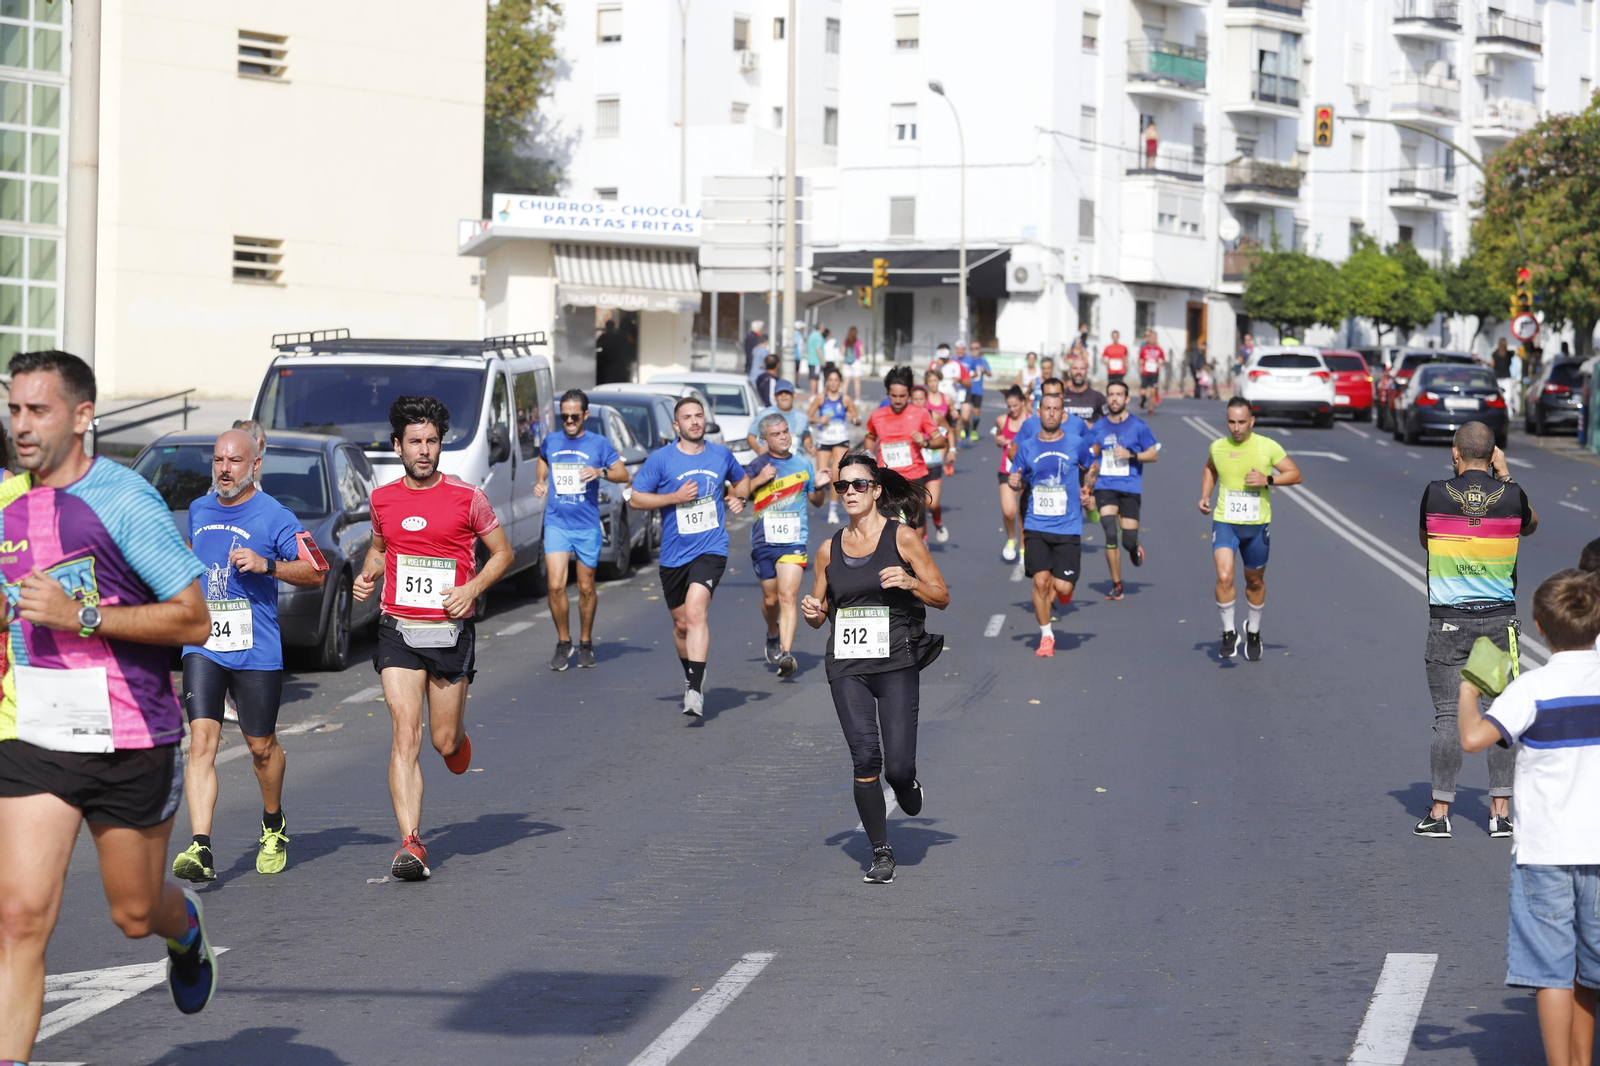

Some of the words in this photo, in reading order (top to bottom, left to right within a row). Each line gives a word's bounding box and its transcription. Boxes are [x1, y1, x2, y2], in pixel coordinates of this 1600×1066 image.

[518, 199, 605, 214] CHURROS
[543, 215, 626, 229] PATATAS
[631, 220, 694, 233] FRITAS
[556, 475, 574, 486] 298
[768, 480, 785, 492] CLUB
[1039, 497, 1055, 508] 203
[1230, 502, 1247, 512] 324
[684, 511, 704, 525] 187
[771, 524, 789, 535] 146
[407, 558, 426, 567] VUELTA
[426, 559, 432, 567] A
[431, 560, 452, 569] HUELVA
[405, 576, 433, 595] 513
[207, 602, 221, 611] UELTA
[226, 602, 248, 610] HUELVA
[843, 609, 860, 618] VUELTA
[864, 609, 885, 617] HUELVA
[843, 627, 868, 645] 512
